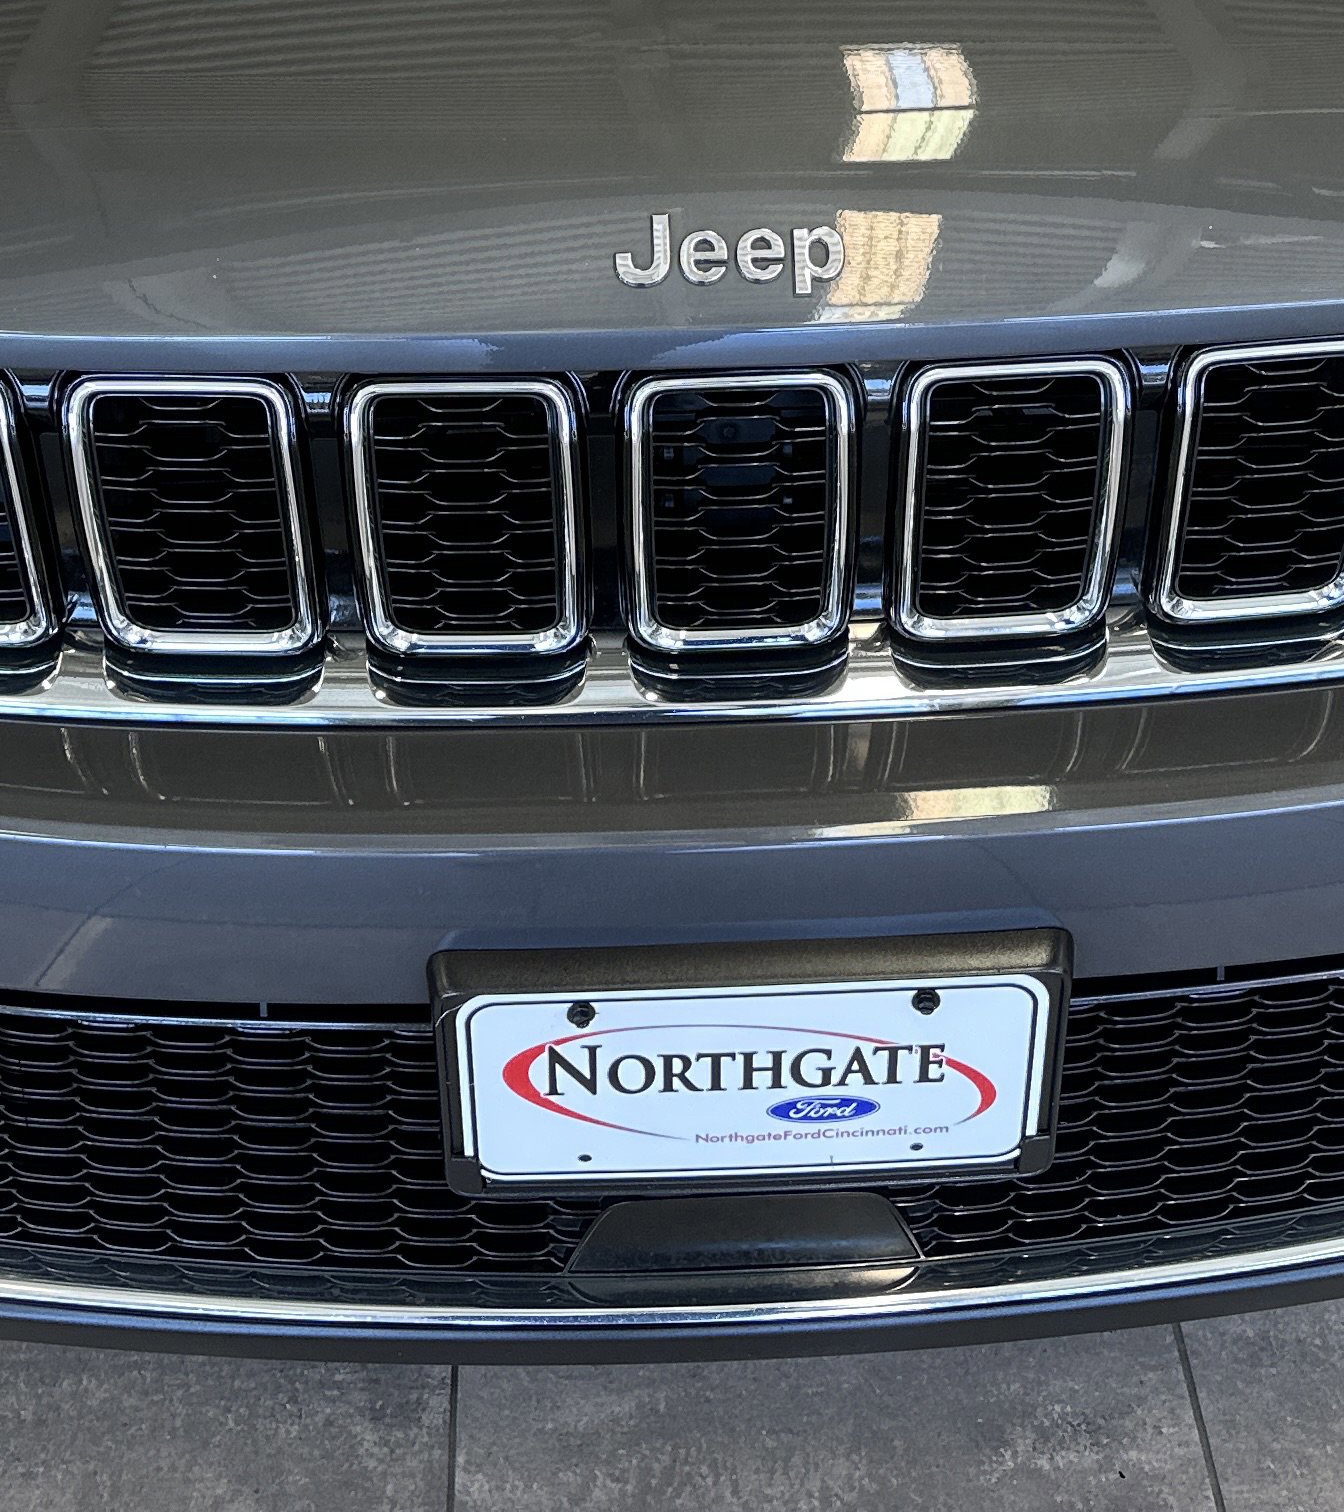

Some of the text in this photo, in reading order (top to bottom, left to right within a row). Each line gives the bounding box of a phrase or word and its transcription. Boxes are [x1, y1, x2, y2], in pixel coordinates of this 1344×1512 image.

[613, 212, 846, 297] Jeep
[543, 1042, 947, 1097] NORTHGATE
[788, 1098, 859, 1120] Ford
[694, 1124, 950, 1145] NorthgateFordCincinnati.com
